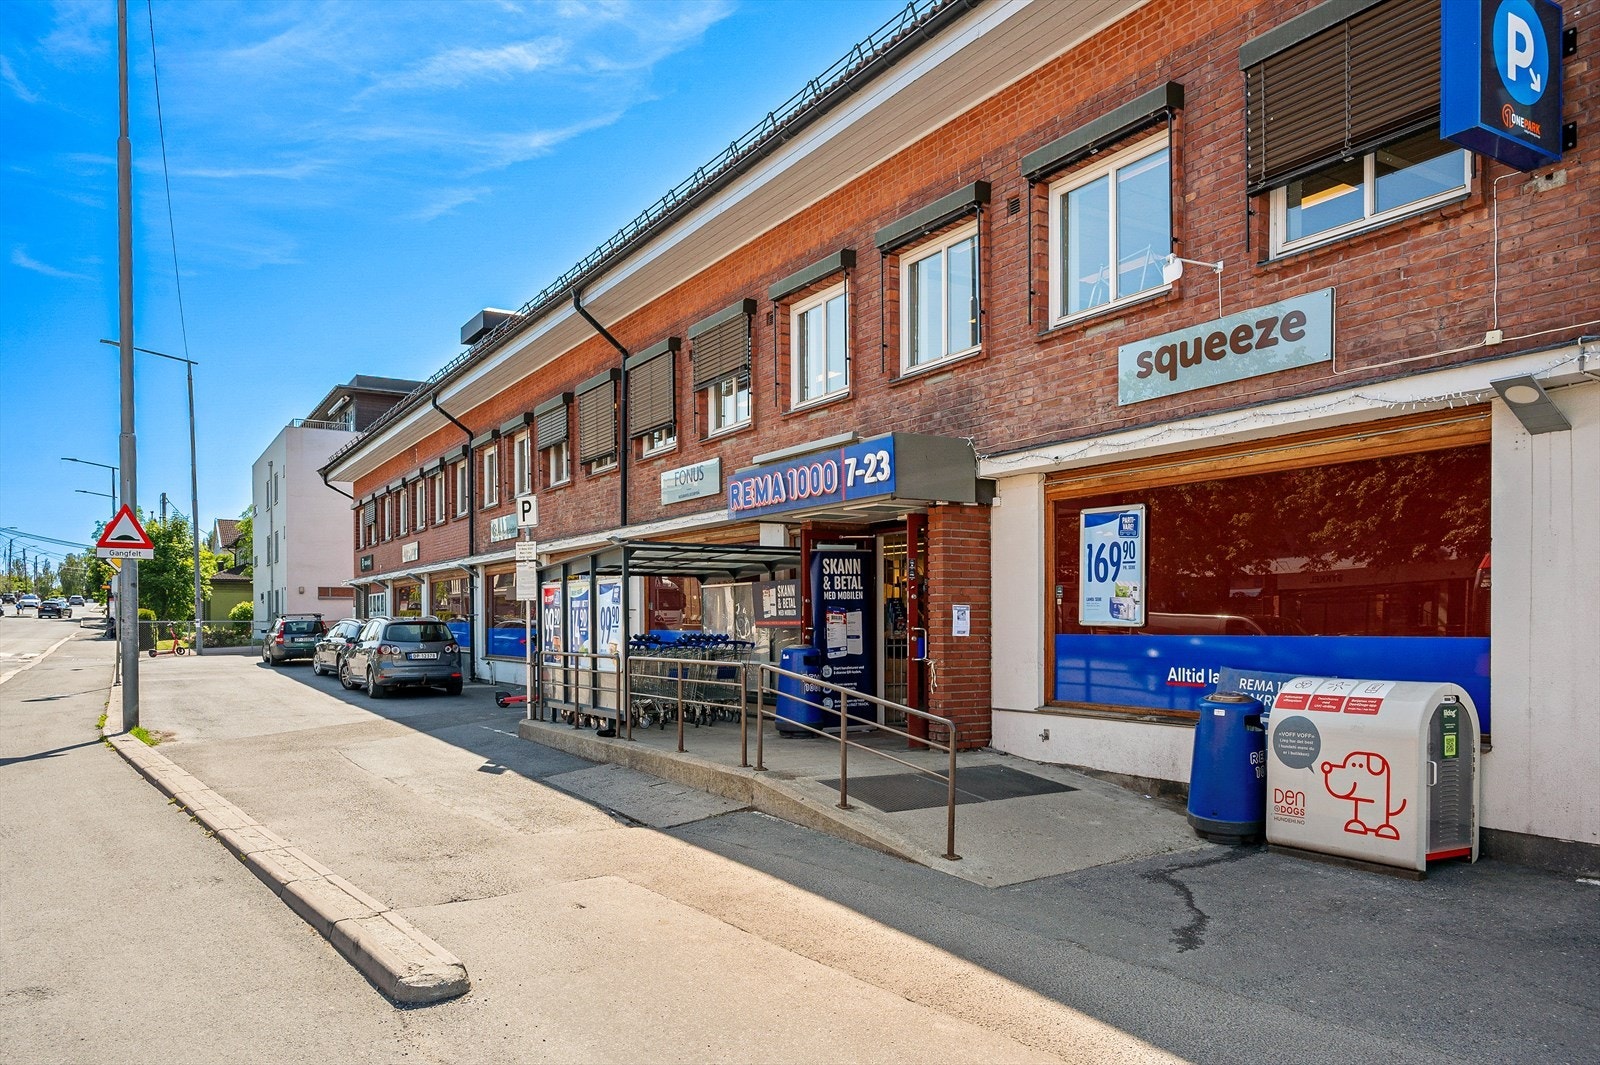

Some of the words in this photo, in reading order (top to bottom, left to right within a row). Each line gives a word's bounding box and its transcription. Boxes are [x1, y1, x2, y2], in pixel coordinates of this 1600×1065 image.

[1507, 11, 1534, 81] P
[1136, 309, 1307, 381] squeeze
[674, 465, 704, 487] FONUS
[729, 471, 786, 512] REMA
[787, 459, 838, 501] 1000
[844, 450, 891, 487] 7-23
[522, 500, 532, 522] P
[109, 549, 142, 558] Gangfelt
[1086, 541, 1122, 583] 169
[1122, 540, 1136, 560] 90
[822, 558, 862, 575] SKANN
[777, 584, 796, 597] SKANN
[822, 575, 832, 590] &
[833, 576, 864, 590] BETAL
[823, 591, 837, 600] MED
[837, 591, 864, 600] MOBILEN
[545, 608, 555, 643] 99
[572, 609, 580, 645] 14
[600, 606, 612, 645] 99
[612, 606, 620, 625] 90
[1167, 667, 1205, 683] Alltid
[1239, 678, 1274, 692] REMA
[1274, 788, 1306, 808] Den
